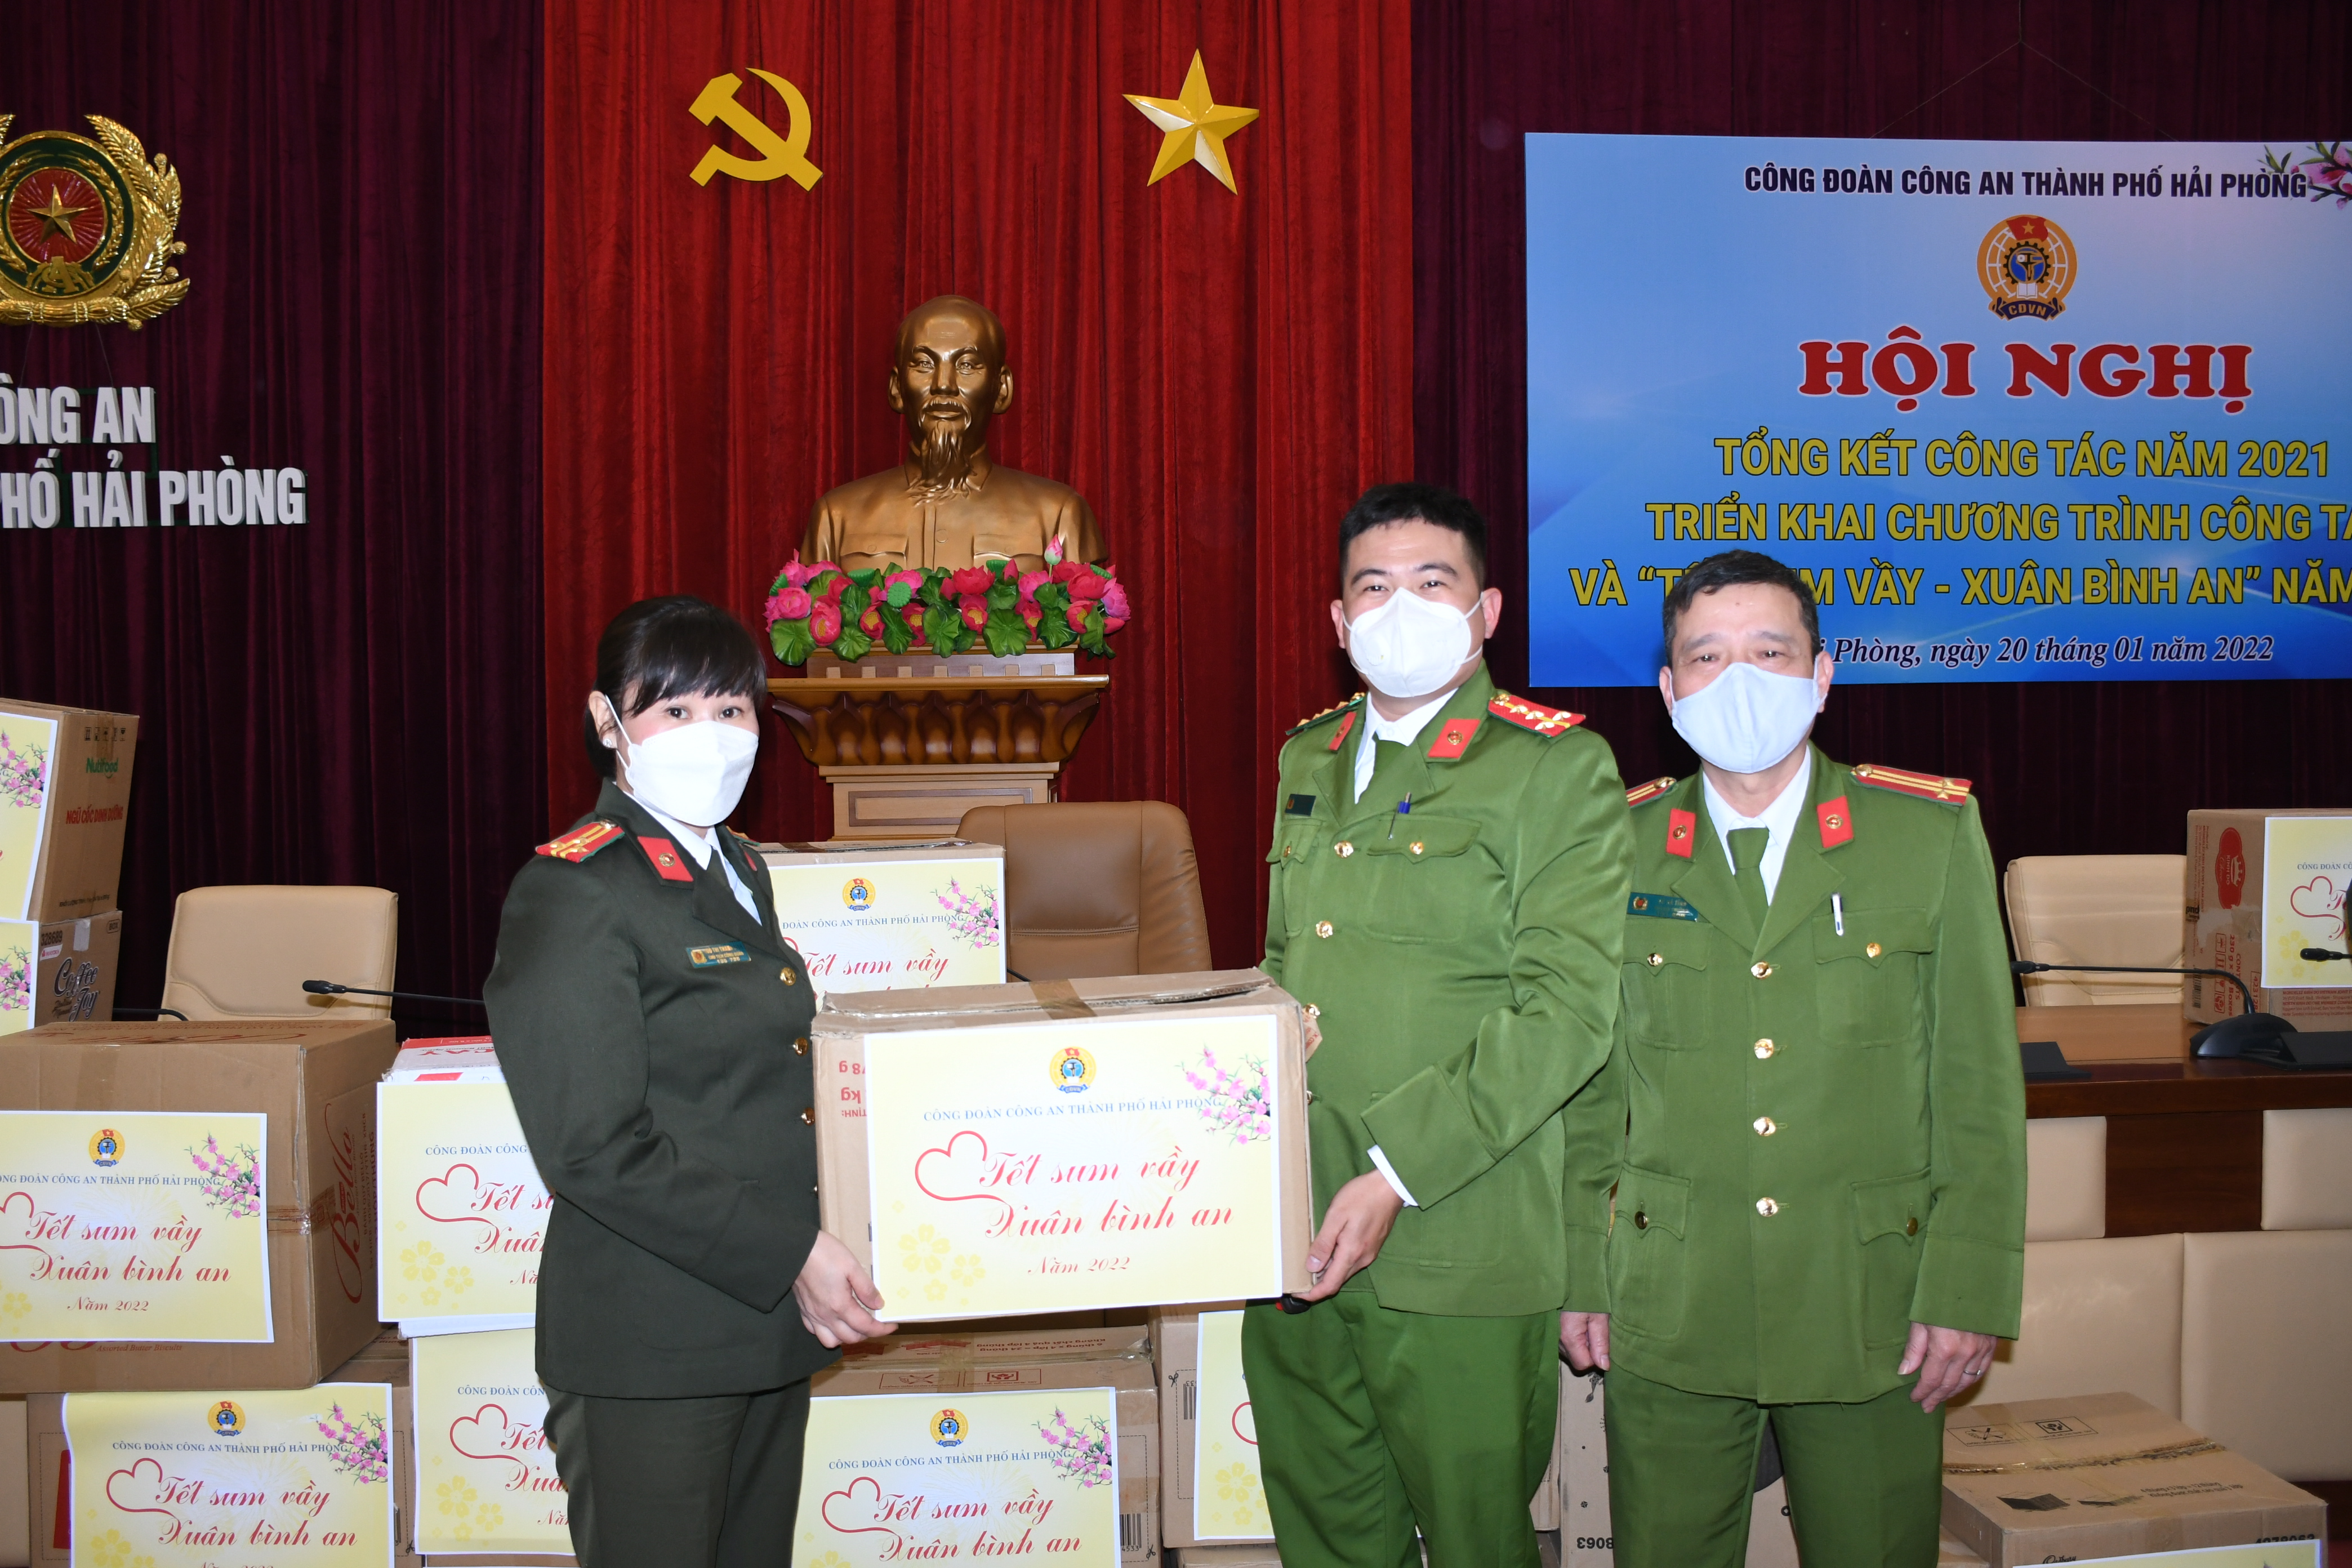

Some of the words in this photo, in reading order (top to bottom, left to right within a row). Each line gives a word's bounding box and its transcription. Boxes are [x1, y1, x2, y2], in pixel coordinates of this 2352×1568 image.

[1745, 162, 1815, 192] CÔNG
[1823, 164, 1892, 193] ĐOÀN
[1901, 166, 1970, 194] CÔNG
[1979, 171, 2013, 195] AN
[2022, 167, 2103, 196] THÀNH
[2113, 165, 2163, 197] PHỐ
[2171, 166, 2211, 197] HẢI
[2221, 168, 2306, 198] PHÒNG
[1799, 325, 1976, 412] HỘI
[2004, 342, 2253, 413] NGHỊ
[0, 372, 81, 444] ÔNG
[92, 386, 156, 443] AN
[1714, 426, 1828, 476] TỔNG
[1839, 428, 1917, 476] KẾT
[1925, 431, 2038, 477] CÔNG
[2047, 432, 2126, 477] TÁC
[2136, 431, 2227, 477] NĂM
[2238, 440, 2328, 477] 2021
[0, 448, 60, 528] HỐ
[72, 449, 147, 527] HẢI
[159, 455, 306, 526] PHÒNG
[1646, 491, 1766, 541] TRIỂN
[1779, 504, 1874, 541] KHAI
[1887, 502, 2058, 541] CHƯƠNG
[2068, 496, 2189, 541] TRÌNH
[2200, 496, 2310, 541] CÔNG
[1569, 560, 1627, 605] VÀ
[1847, 557, 1923, 605] VẦY
[1961, 559, 2070, 605] XUÂN
[2087, 559, 2177, 604] BÌNH
[2187, 565, 2261, 604] AN”
[1833, 639, 1921, 666] Phòng,
[1930, 640, 1989, 666] ngày
[1997, 637, 2027, 662] 20
[2034, 636, 2108, 666] tháng
[2114, 637, 2142, 661] 01
[2150, 639, 2206, 661] năm
[2214, 636, 2274, 661] 2022
[782, 919, 809, 929] ĐOÀN
[812, 917, 838, 928] CÔNG
[856, 916, 888, 926] THÀNH
[890, 914, 910, 925] PHỐ
[913, 912, 929, 924] HẢI
[932, 912, 964, 923] PHÒNG
[54, 957, 99, 997] Coffee
[843, 959, 892, 975] sum
[904, 948, 949, 982] vầy
[69, 987, 98, 1022] Joy
[839, 1061, 848, 1073] g
[841, 1087, 862, 1104] kg
[924, 1108, 960, 1121] CÔNG
[965, 1106, 1002, 1120] ĐOÀN
[1006, 1104, 1043, 1117] CÔNG
[1047, 1104, 1065, 1115] AN
[1068, 1100, 1114, 1114] THÀNH
[1119, 1097, 1145, 1111] PHỐ
[1150, 1097, 1172, 1110] HẢI
[1177, 1097, 1222, 1108] PHÒNG
[425, 1144, 457, 1155] CÔNG
[460, 1143, 492, 1155] ĐOÀN
[496, 1143, 527, 1154] CÔNG
[20, 1173, 49, 1183] ĐOÀN
[52, 1173, 80, 1184] CÔNG
[83, 1175, 97, 1184] AN
[100, 1173, 135, 1184] THÀNH
[139, 1173, 160, 1185] PHỐ
[163, 1174, 181, 1185] HẢI
[184, 1174, 220, 1186] PHÒNG
[979, 1152, 1040, 1188] Tết
[1050, 1161, 1120, 1183] sum
[1138, 1146, 1200, 1191] vầy
[471, 1182, 525, 1211] Tết
[25, 1211, 76, 1241] Tết
[82, 1223, 138, 1241] sum
[150, 1214, 203, 1252] vầy
[985, 1201, 1085, 1238] Xuân
[1100, 1197, 1177, 1231] bình
[1192, 1204, 1234, 1226] an
[30, 1252, 111, 1282] Xuân
[122, 1255, 184, 1282] bình
[195, 1267, 231, 1282] an
[1027, 1256, 1079, 1275] Năm
[1087, 1255, 1131, 1272] 2022
[67, 1297, 109, 1312] Năm
[115, 1299, 149, 1312] 2022
[457, 1385, 487, 1395] CÔNG
[490, 1385, 519, 1396] ĐOÀN
[523, 1386, 545, 1396] CÔN
[113, 1441, 141, 1450] CÔNG
[144, 1441, 173, 1451] ĐOÀN
[176, 1441, 205, 1451] CÔNG
[226, 1442, 259, 1453] THÀNH
[263, 1442, 286, 1453] PHỐ
[289, 1442, 308, 1453] HẢI
[311, 1443, 348, 1453] PHÒNG
[828, 1459, 859, 1469] CÔNG
[862, 1458, 892, 1468] ĐOÀN
[895, 1456, 925, 1467] CÔNG
[928, 1456, 942, 1465] AN
[946, 1453, 982, 1464] THÀNH
[986, 1450, 1008, 1462] PHỐ
[1012, 1450, 1030, 1460] HẢI
[1034, 1450, 1071, 1459] PHÒNG
[155, 1476, 204, 1505] Tết
[210, 1488, 266, 1506] sum
[279, 1481, 331, 1517] vầy
[874, 1494, 925, 1522] Tết
[931, 1501, 990, 1520] sum
[1000, 1489, 1054, 1525] vầy
[158, 1518, 238, 1547] Xuân
[250, 1520, 311, 1547] bình
[322, 1533, 357, 1547] an
[879, 1532, 960, 1562] Xuân
[971, 1529, 1035, 1557] bình
[1046, 1537, 1083, 1553] an
